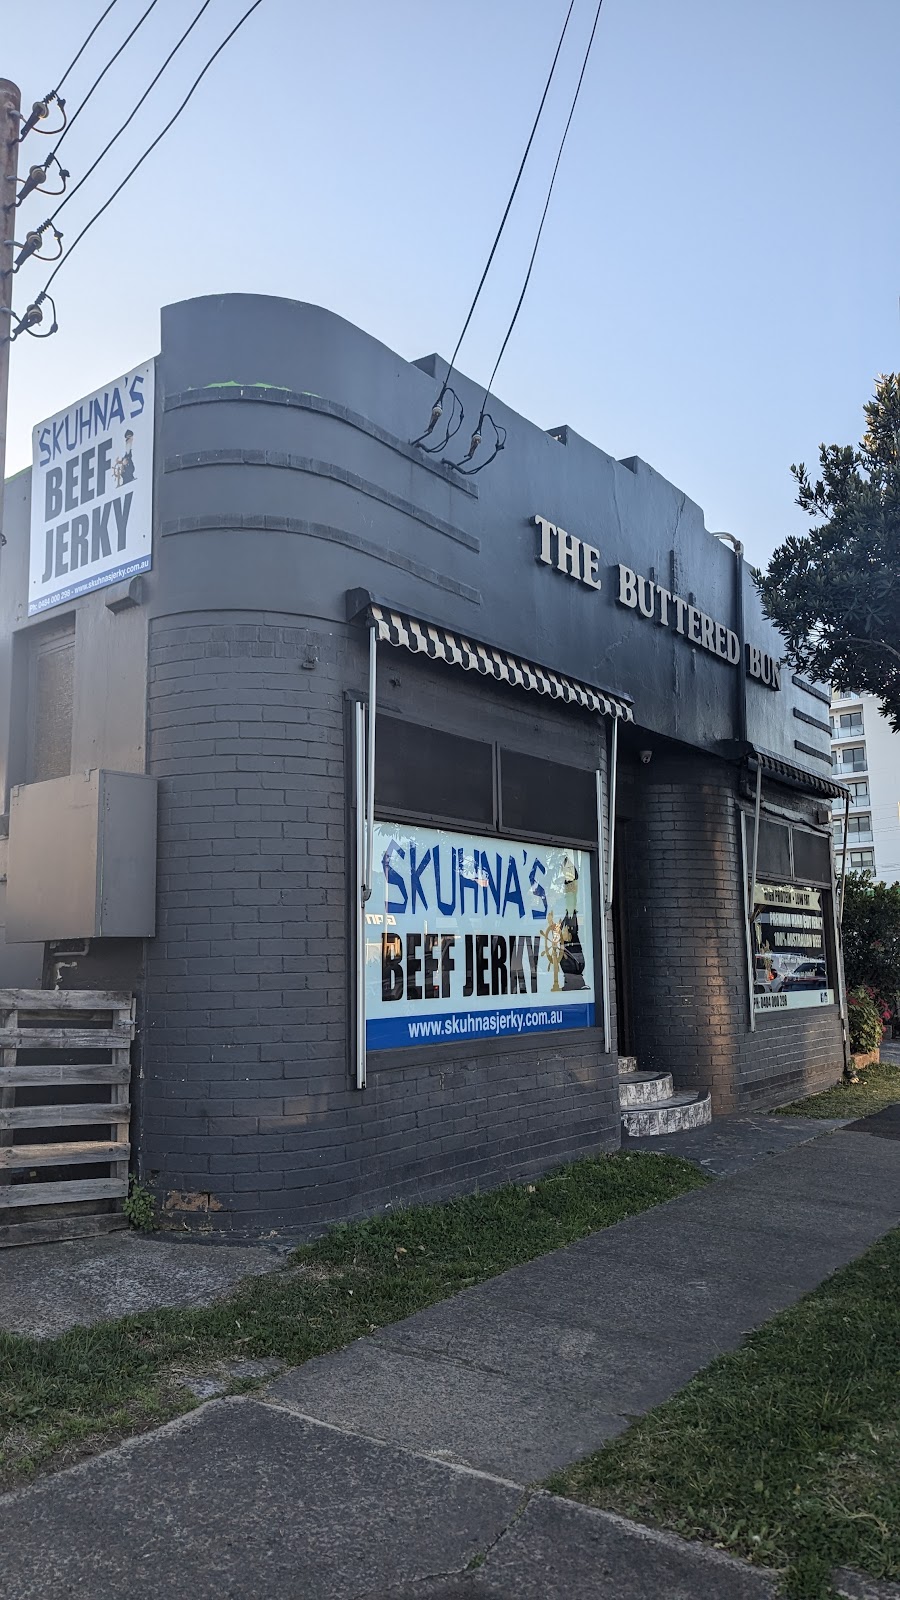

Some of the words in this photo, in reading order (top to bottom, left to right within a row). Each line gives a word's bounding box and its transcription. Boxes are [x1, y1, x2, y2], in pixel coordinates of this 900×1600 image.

[38, 375, 145, 468] SKUHNA'S
[44, 437, 113, 523] BEEF
[41, 491, 134, 584] JERKY
[74, 560, 149, 594] www.skuhnasjerky.com.au
[534, 514, 602, 591] THE
[618, 563, 741, 666] BUTTERED
[749, 645, 782, 691] BUN
[381, 838, 549, 920] SKUHNA'S
[381, 932, 456, 1002] BEEF
[462, 934, 541, 997] JERKY
[408, 1009, 563, 1038] www.skuhnasjerky.com.au
